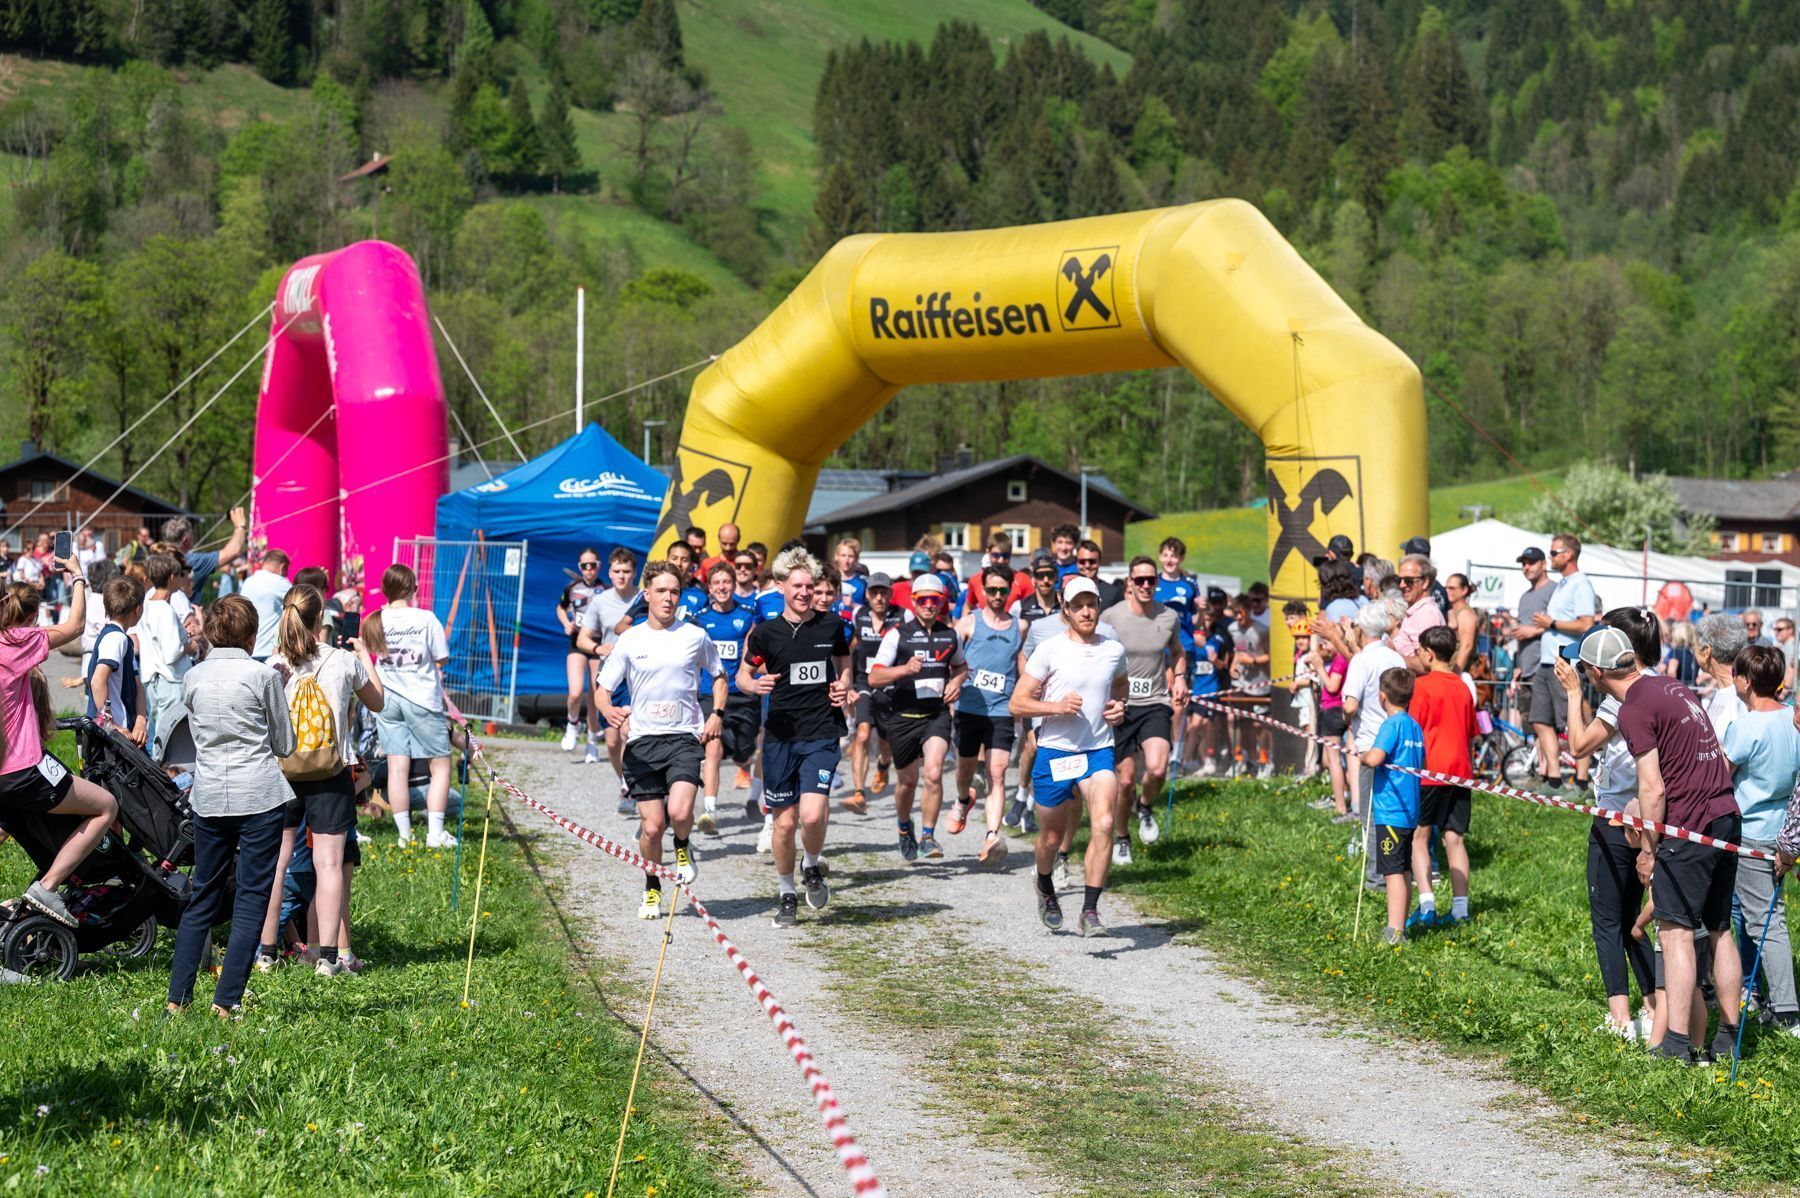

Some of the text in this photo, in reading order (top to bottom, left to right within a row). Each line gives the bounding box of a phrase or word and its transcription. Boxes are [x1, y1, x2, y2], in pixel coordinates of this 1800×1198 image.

[870, 291, 1051, 340] Raiffeisen
[714, 643, 736, 657] 79
[798, 665, 819, 681] 80
[980, 674, 998, 689] 54
